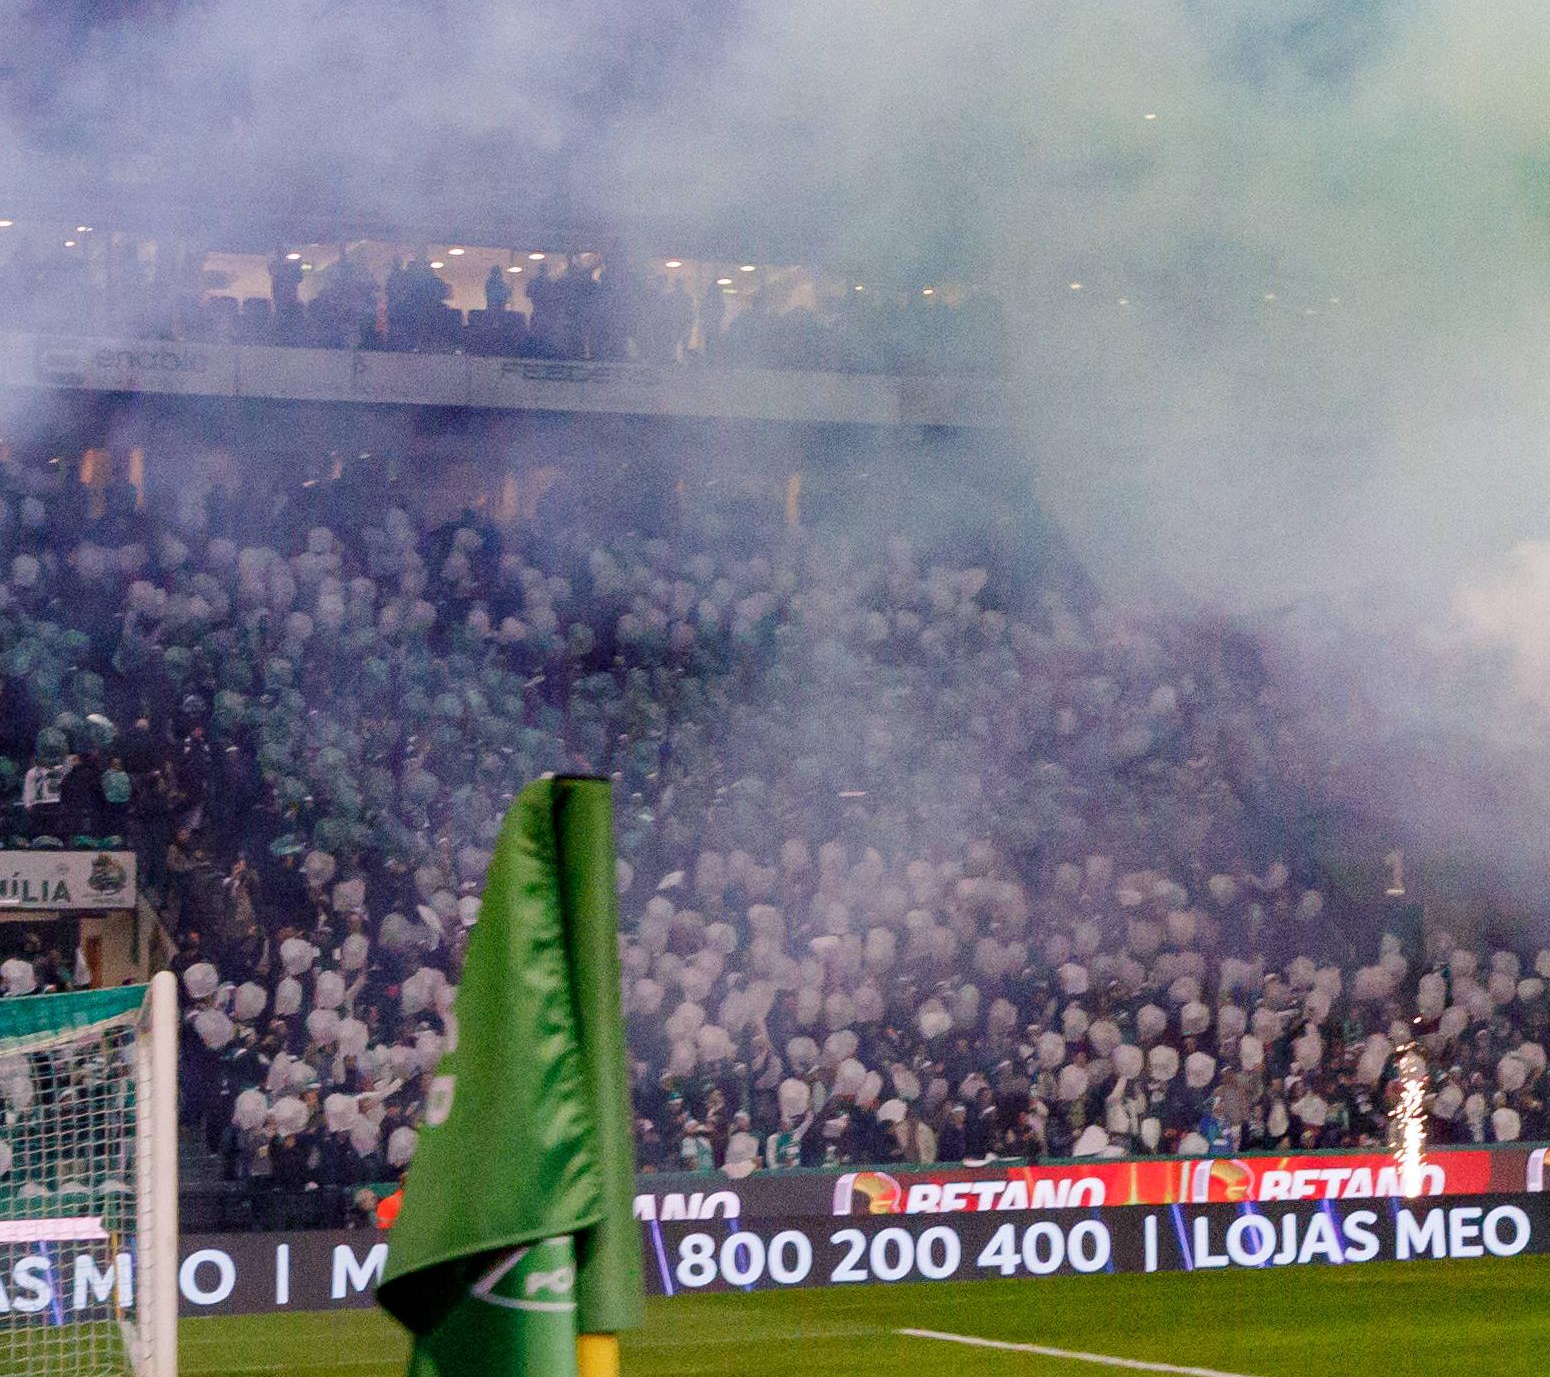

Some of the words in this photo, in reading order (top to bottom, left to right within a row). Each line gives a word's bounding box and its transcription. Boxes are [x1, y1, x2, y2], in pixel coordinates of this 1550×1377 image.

[676, 1229, 813, 1289] 800
[829, 1224, 963, 1283] 200
[976, 1219, 1112, 1276] 400
[1193, 1208, 1379, 1270] LOJAS
[1396, 1203, 1532, 1261] MEO
